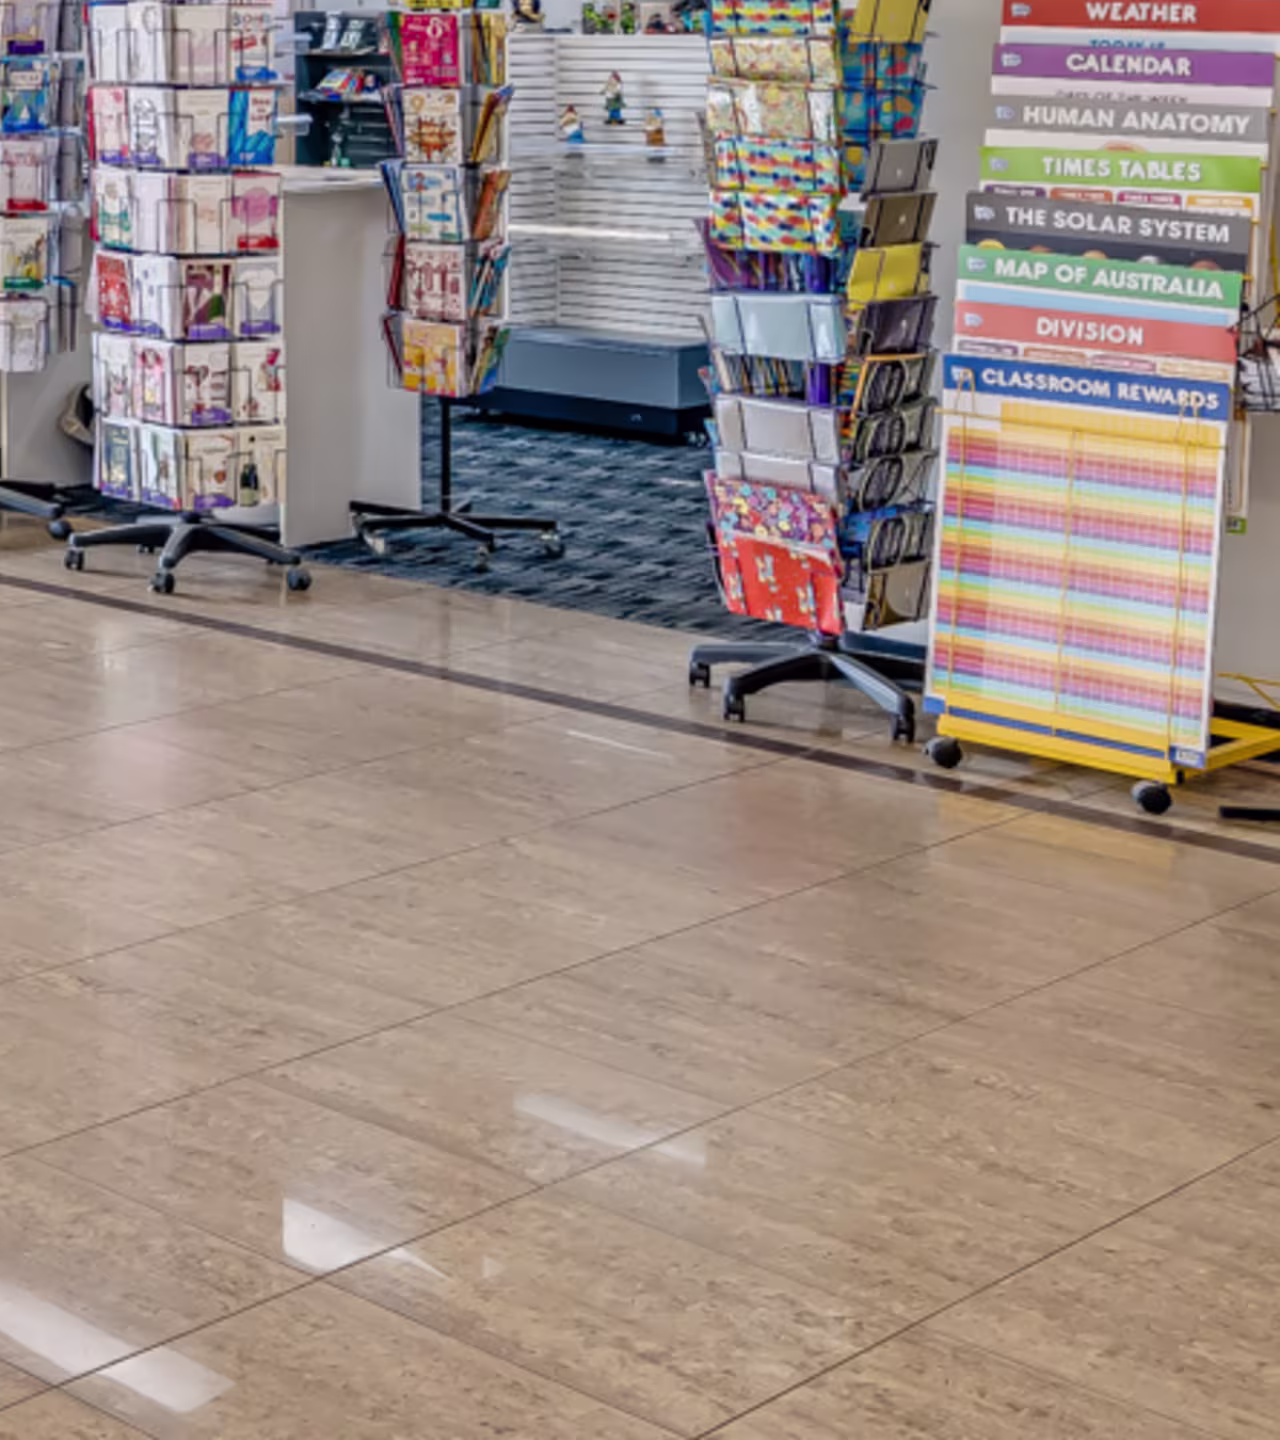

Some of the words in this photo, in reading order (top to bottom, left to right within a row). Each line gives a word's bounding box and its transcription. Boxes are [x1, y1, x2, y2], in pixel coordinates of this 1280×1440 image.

[1085, 1, 1197, 23] WEATHER
[1065, 53, 1192, 76] CALENDAR
[1023, 106, 1114, 128] HUMAN
[1122, 111, 1250, 135] ANATOMY
[1043, 156, 1110, 179] TIMES
[1120, 159, 1201, 182] TABLES
[1006, 206, 1045, 226] THE
[1053, 211, 1131, 235] SOLAR
[1139, 217, 1229, 243] SYSTEM
[994, 258, 1048, 279] MAP
[1055, 263, 1087, 283] OF
[1093, 269, 1225, 300] AUSTRALIA
[1036, 316, 1143, 345] DIVISION
[981, 369, 1111, 398] CLASSROOM
[1117, 383, 1219, 410] REWARDS
